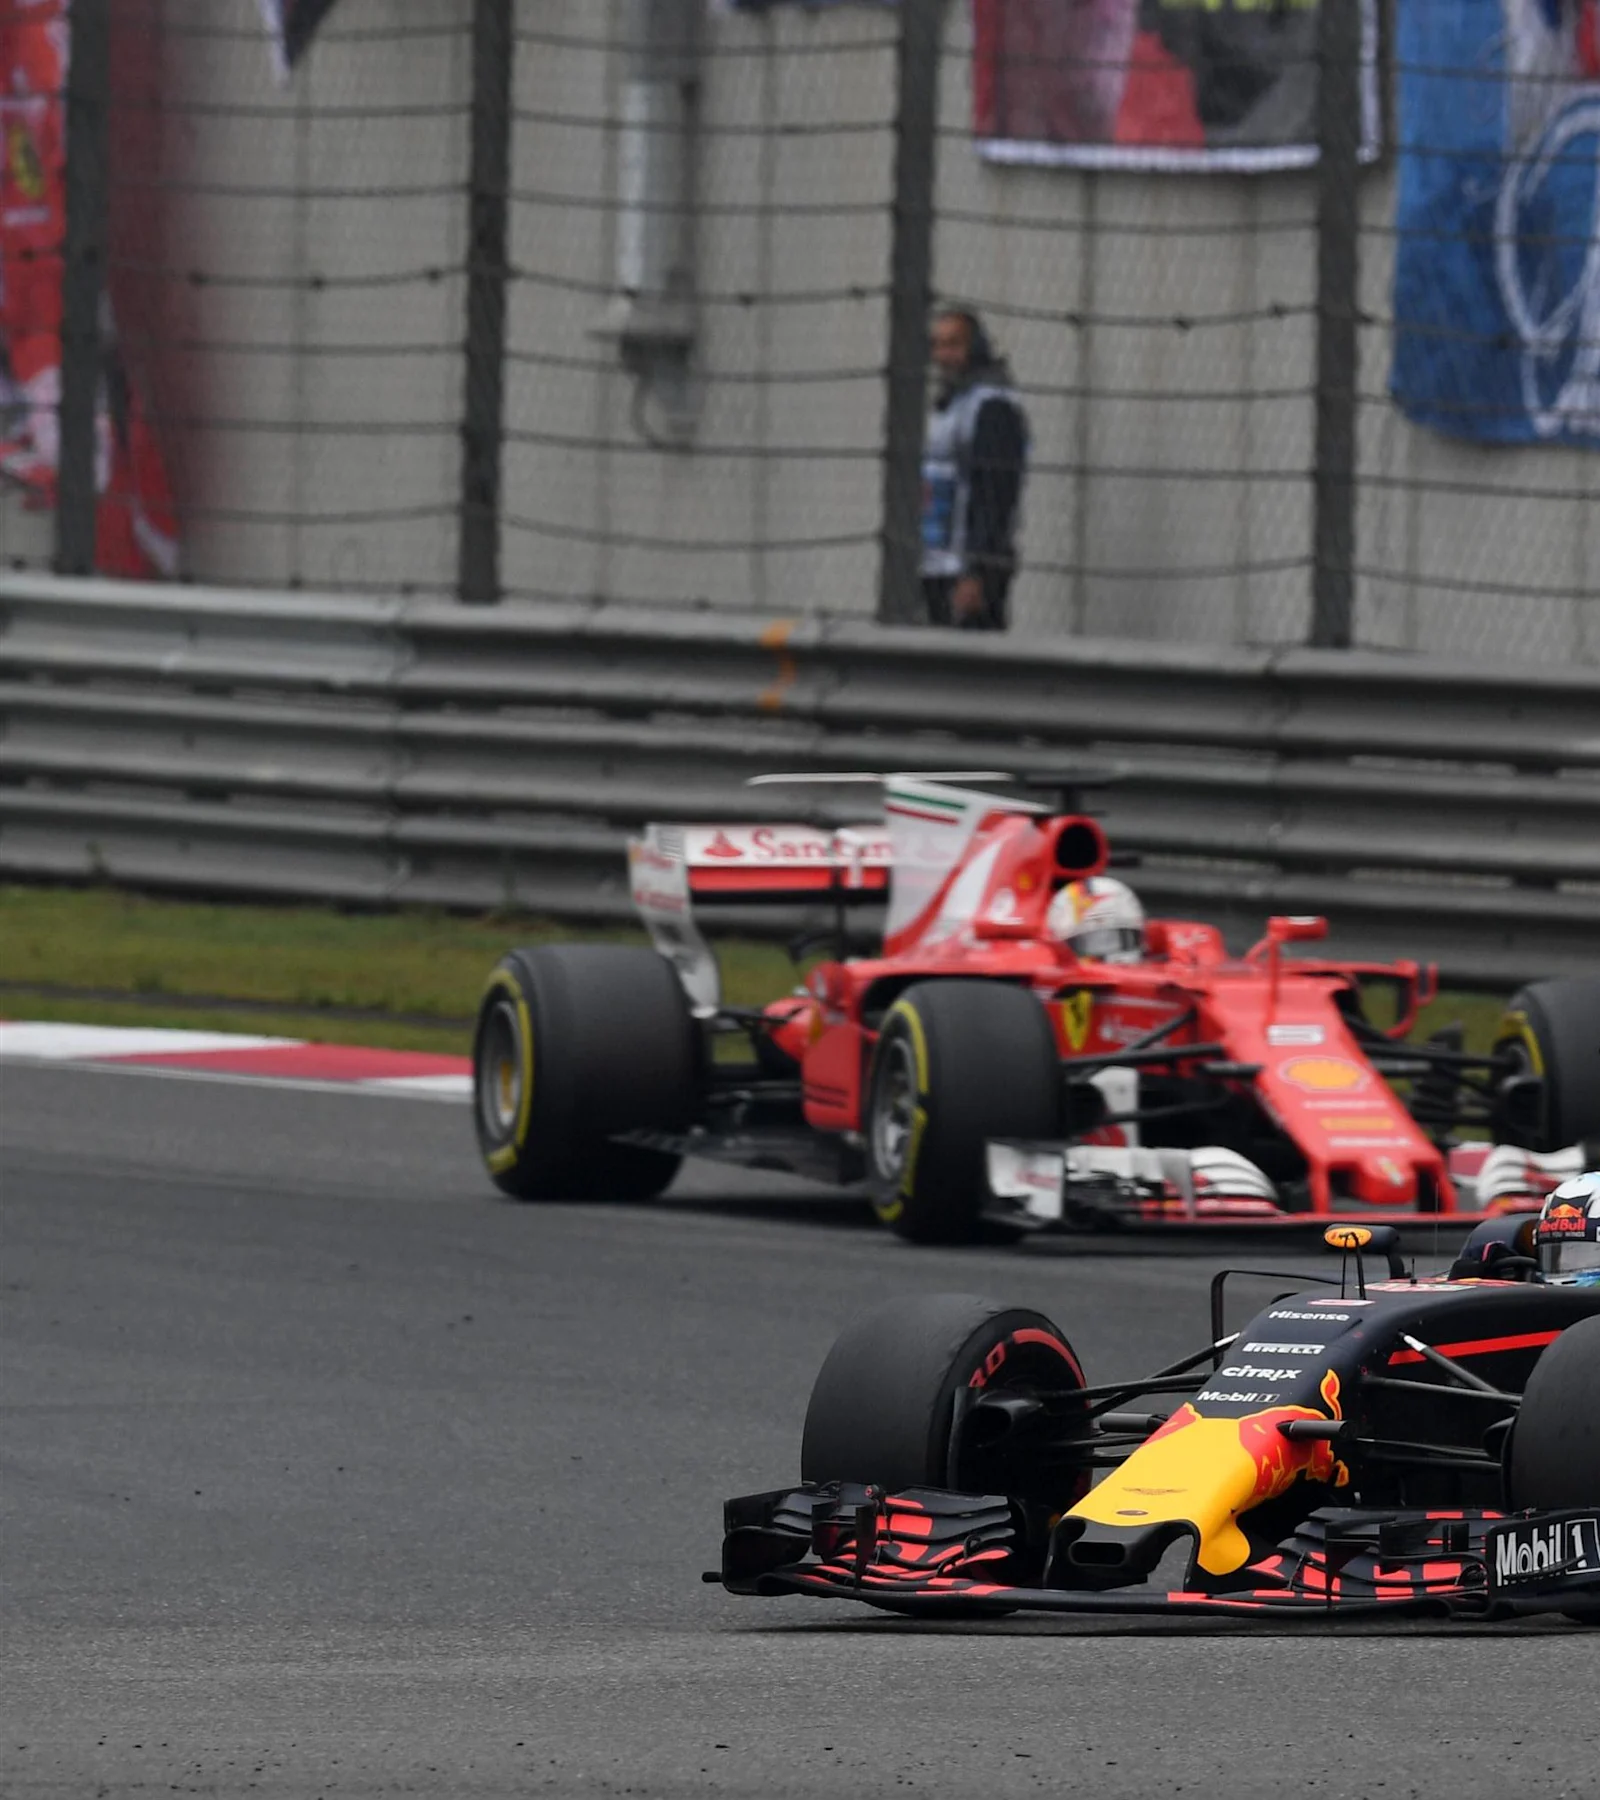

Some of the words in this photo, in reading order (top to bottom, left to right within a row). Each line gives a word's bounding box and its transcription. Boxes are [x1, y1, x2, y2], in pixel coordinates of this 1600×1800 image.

[752, 827, 893, 860] Sanan
[1559, 1217, 1586, 1231] Bull
[1268, 1310, 1351, 1321] Hisense
[1242, 1342, 1326, 1355] PIRELLI
[1197, 1391, 1258, 1403] Mobil
[1496, 1523, 1562, 1587] Mobil
[1571, 1523, 1588, 1569] 1
